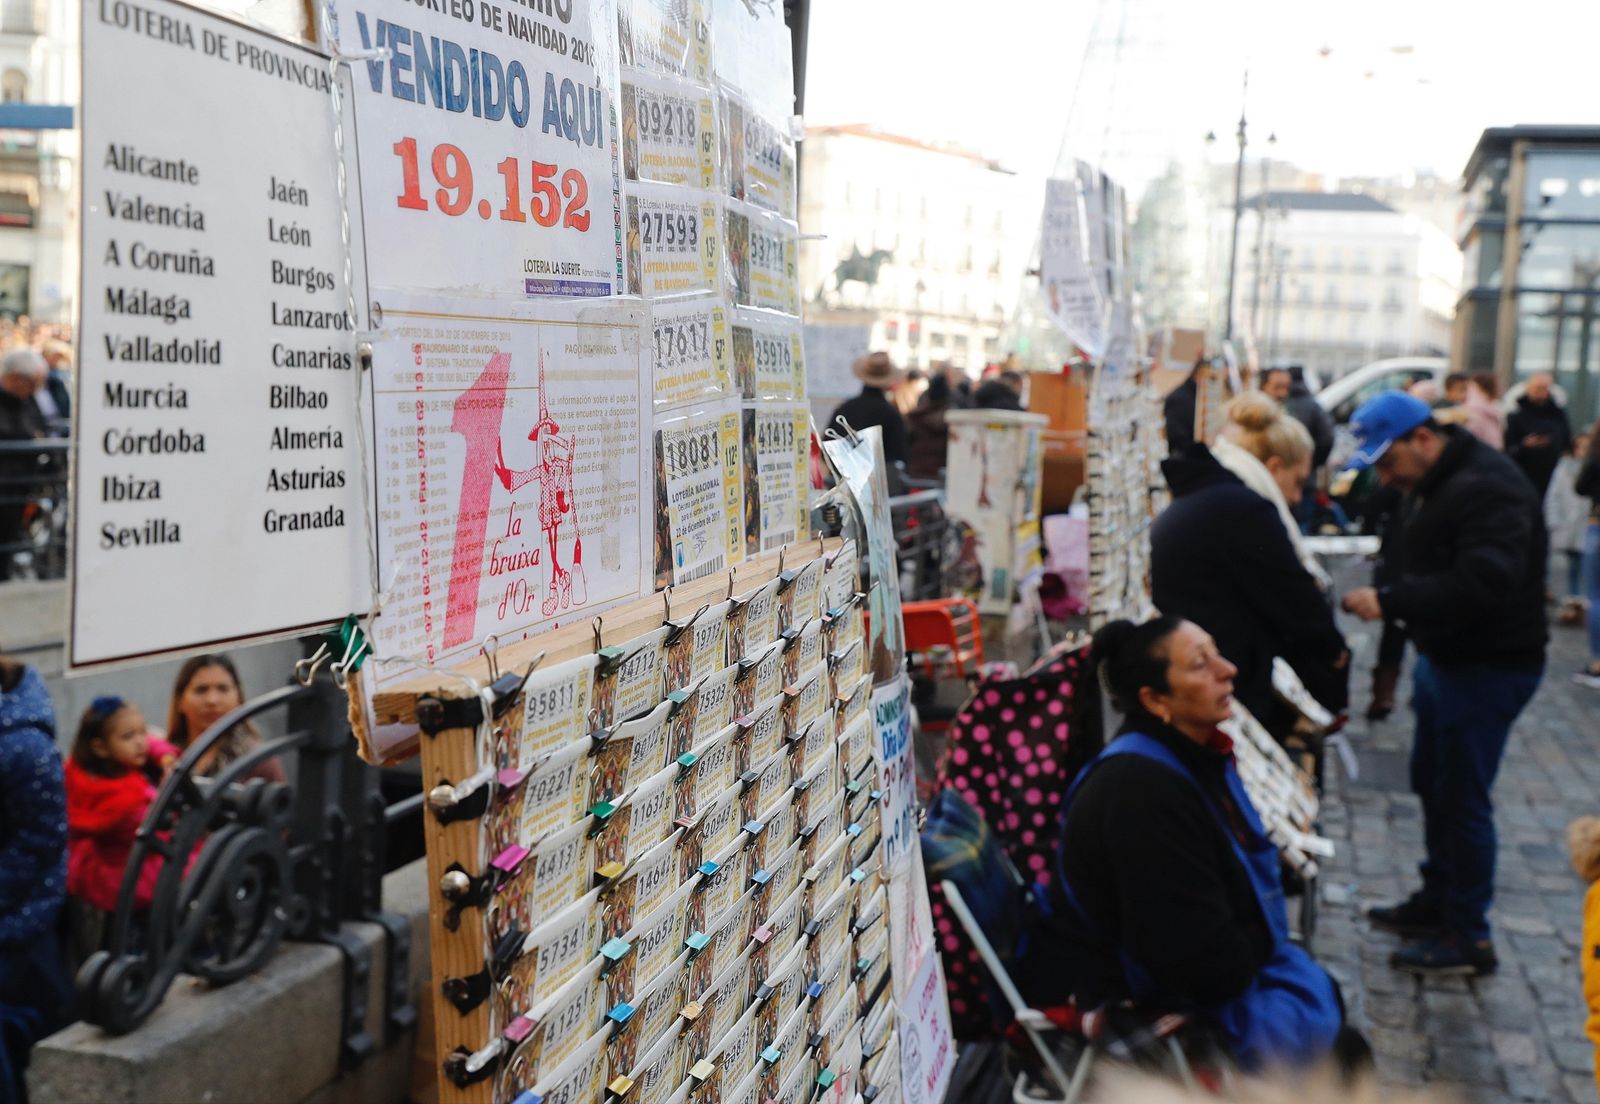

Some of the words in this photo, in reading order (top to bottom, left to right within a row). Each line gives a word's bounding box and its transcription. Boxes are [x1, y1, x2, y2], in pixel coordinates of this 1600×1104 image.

[100, 0, 196, 50] LOTERIA
[201, 29, 231, 62] DE
[480, 2, 502, 32] DE
[507, 11, 567, 56] NAVIDAD
[356, 11, 530, 129] VENDIDO
[541, 72, 604, 150] AQUÍ
[638, 100, 696, 137] 09218
[105, 143, 199, 186] Alicante
[268, 176, 308, 207] Jaén
[393, 136, 591, 233] 19.152
[105, 190, 205, 231] Valencia
[268, 217, 311, 248] León
[641, 212, 698, 245] 27593
[104, 239, 121, 267] A
[131, 241, 215, 277] Coruña
[524, 259, 551, 274] LOTERIA
[552, 261, 560, 275] LA
[560, 262, 581, 276] SUERTE
[271, 259, 335, 294] Burgos
[105, 287, 191, 324] Málaga
[271, 301, 352, 331] Lanzarot
[104, 334, 221, 365] Valladolid
[271, 343, 352, 371] Canarias
[565, 343, 581, 355] PAGO
[653, 322, 708, 361] 17617
[103, 381, 189, 409] Murcia
[269, 385, 329, 409] Bilbao
[103, 427, 205, 456] Córdoba
[270, 425, 344, 451] Almería
[757, 421, 794, 448] 41413
[667, 430, 720, 474] 18081
[102, 475, 161, 503] Ibiza
[266, 465, 346, 493] Asturias
[100, 519, 181, 550] Sevilla
[263, 505, 345, 534] Granada
[505, 501, 522, 538] la
[489, 540, 541, 577] bruixa
[620, 650, 656, 683] 24712
[528, 683, 574, 720] 95811
[699, 683, 726, 709] 75323
[527, 765, 573, 807] 70221
[634, 791, 665, 828] 11632
[540, 915, 586, 973] 57341
[546, 987, 589, 1043] 41251
